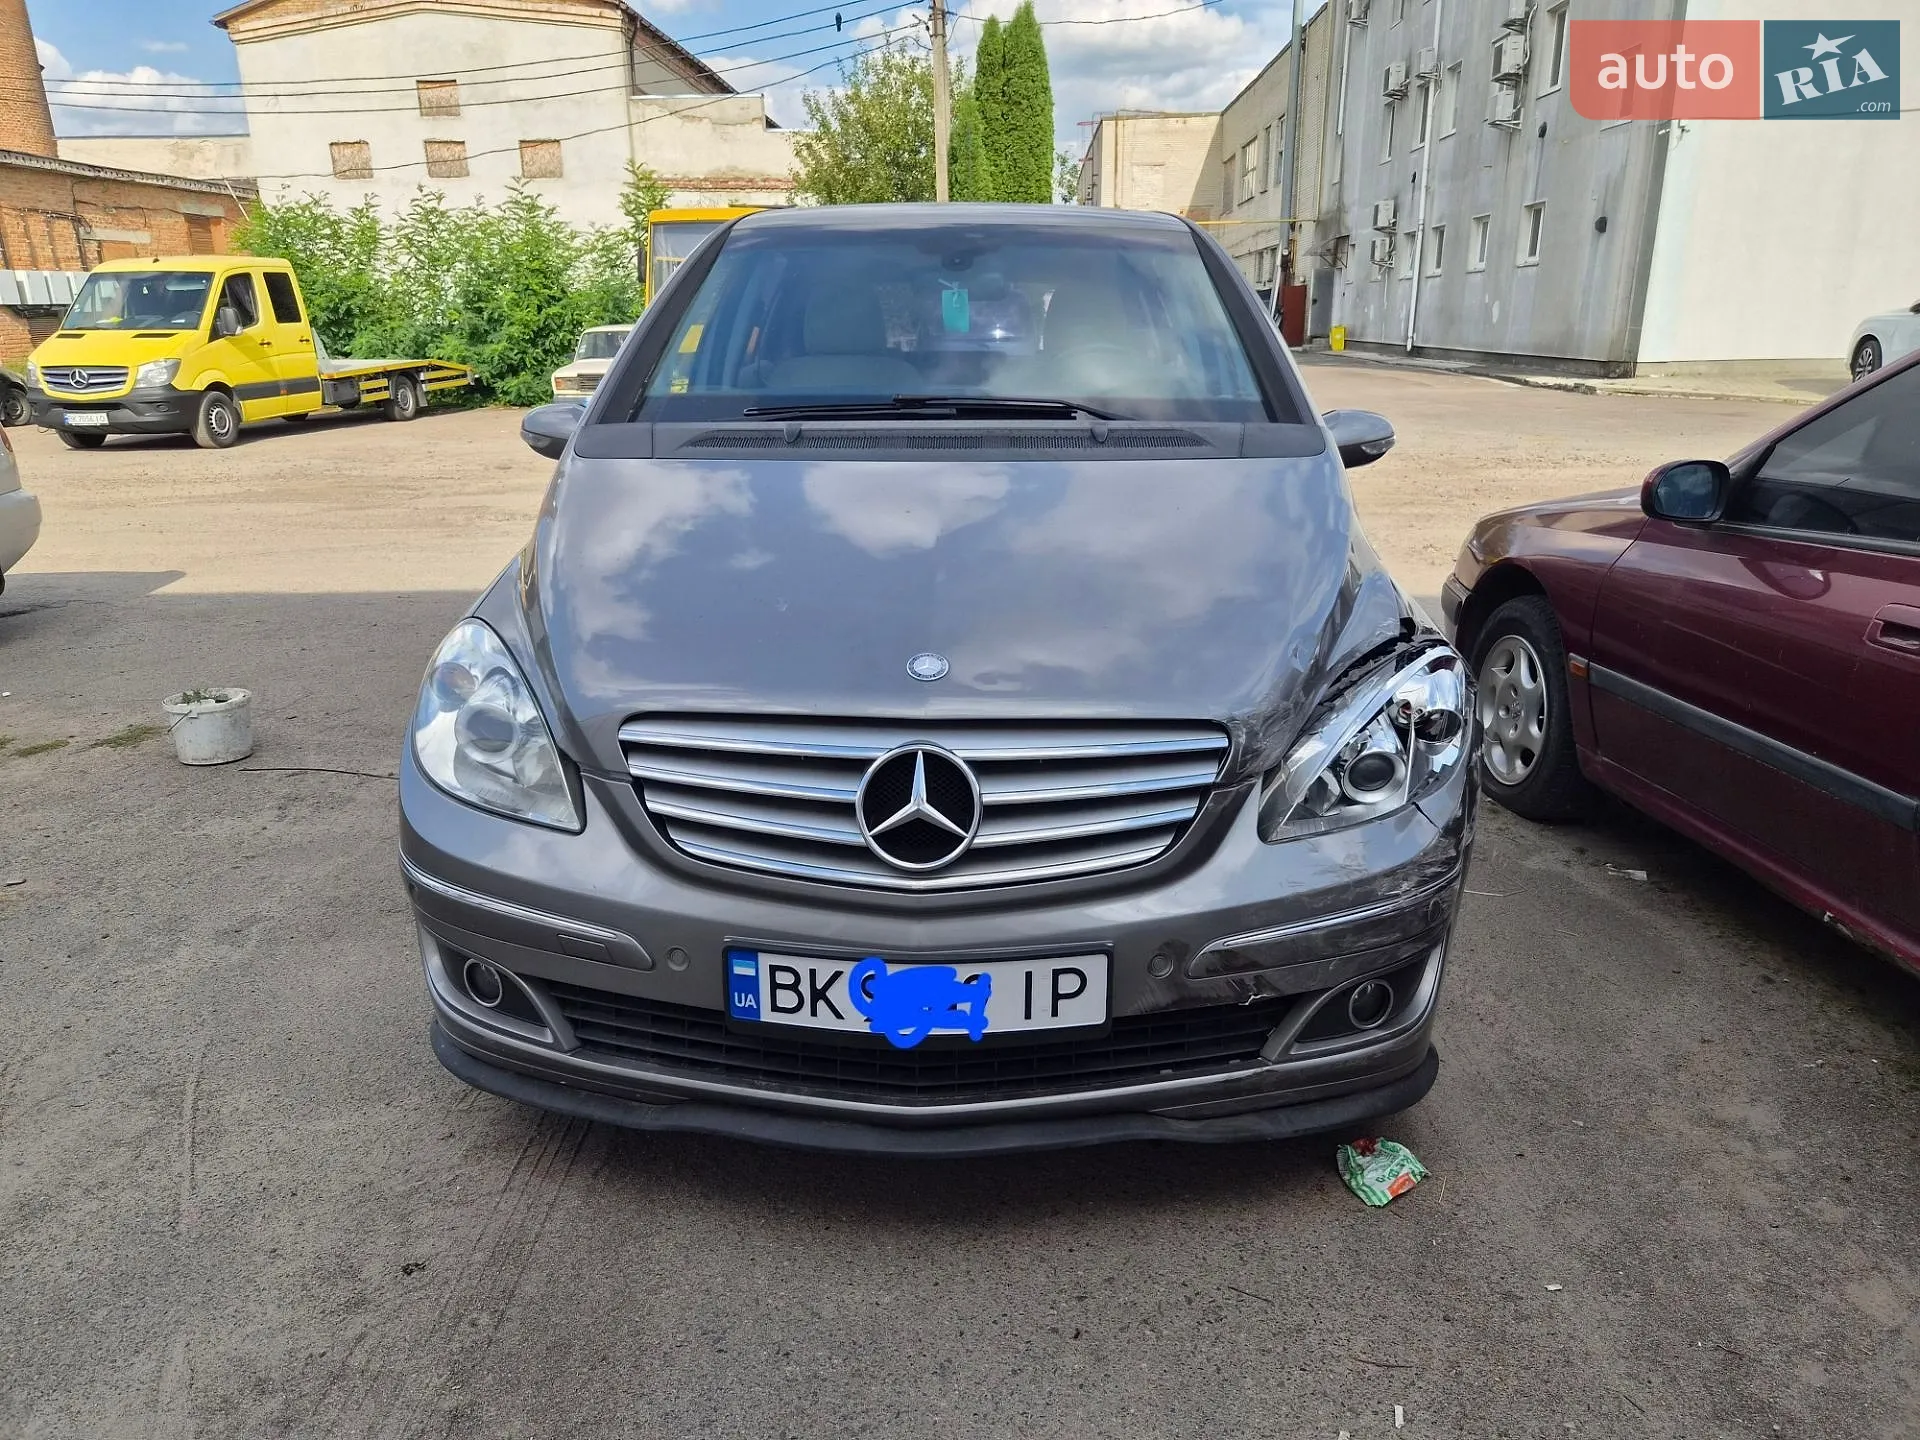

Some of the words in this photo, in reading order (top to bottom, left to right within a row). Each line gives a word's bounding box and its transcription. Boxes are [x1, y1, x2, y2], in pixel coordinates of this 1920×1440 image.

[735, 992, 757, 1009] UA
[769, 964, 845, 1020] BK
[1024, 966, 1088, 1020] IP
